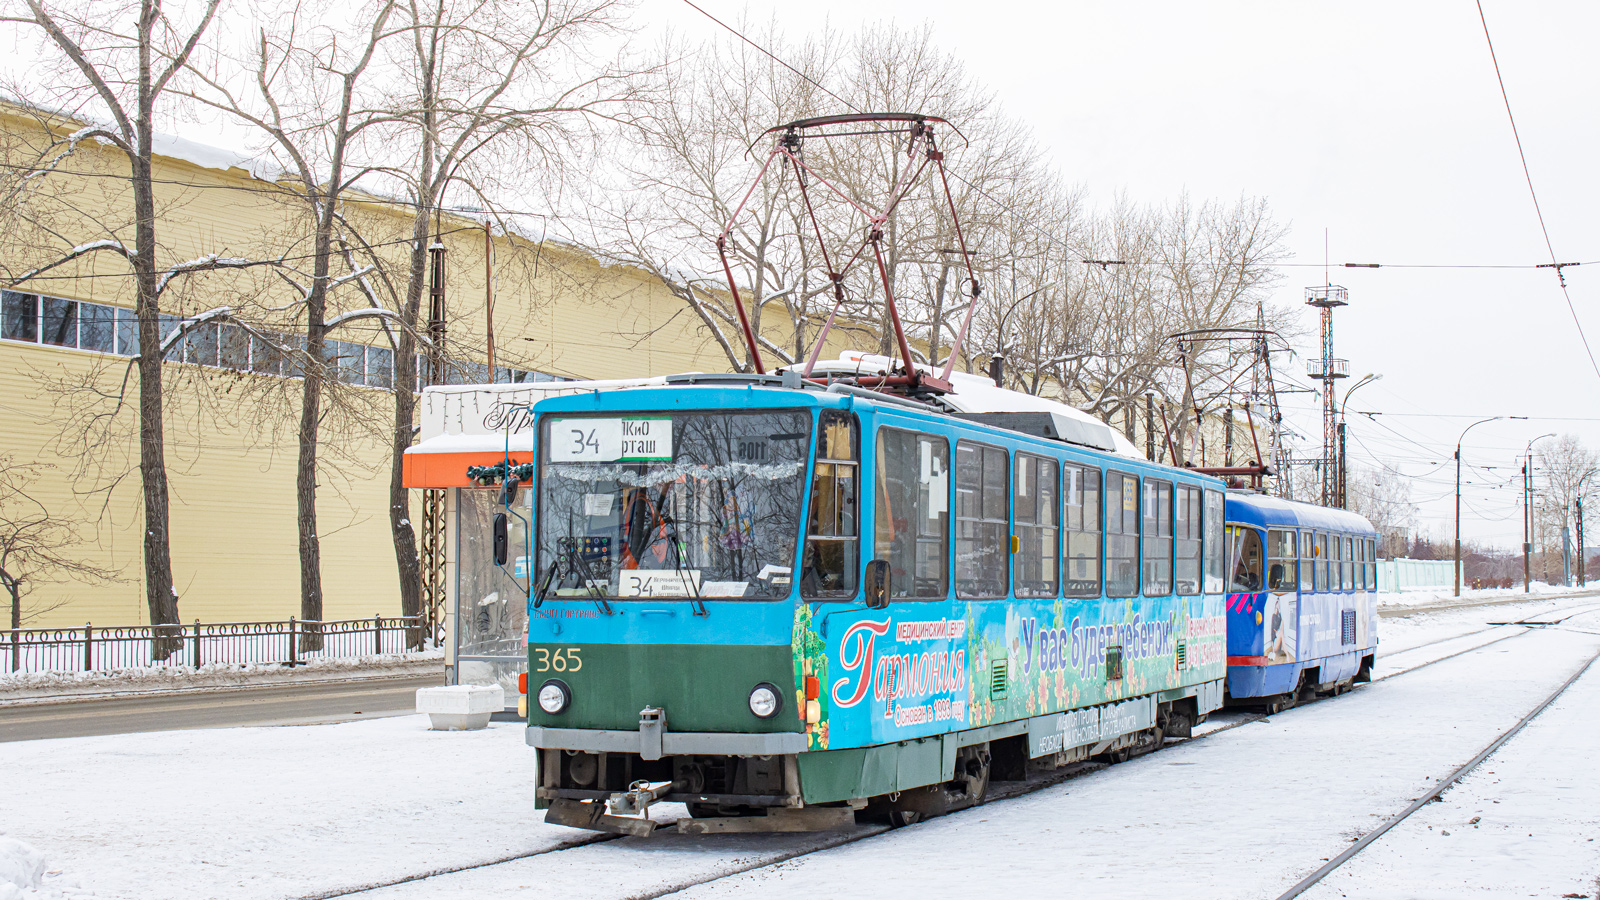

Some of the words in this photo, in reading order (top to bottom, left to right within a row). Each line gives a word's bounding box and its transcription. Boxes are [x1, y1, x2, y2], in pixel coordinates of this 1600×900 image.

[571, 428, 600, 454] 34
[622, 440, 656, 457] рташ
[629, 576, 653, 597] 34
[896, 617, 946, 645] МЕДИЦИНСКИЙ
[946, 620, 965, 642] ЦЕНТР
[1022, 617, 1036, 675] У
[1038, 628, 1067, 673] вас
[1070, 616, 1114, 681] будет
[1116, 610, 1173, 673] ребенок!
[535, 648, 583, 672] 365
[832, 616, 965, 718] Гармония
[894, 704, 927, 727] Основан
[927, 705, 934, 722] в
[934, 698, 951, 721] 1993
[951, 700, 965, 722] году
